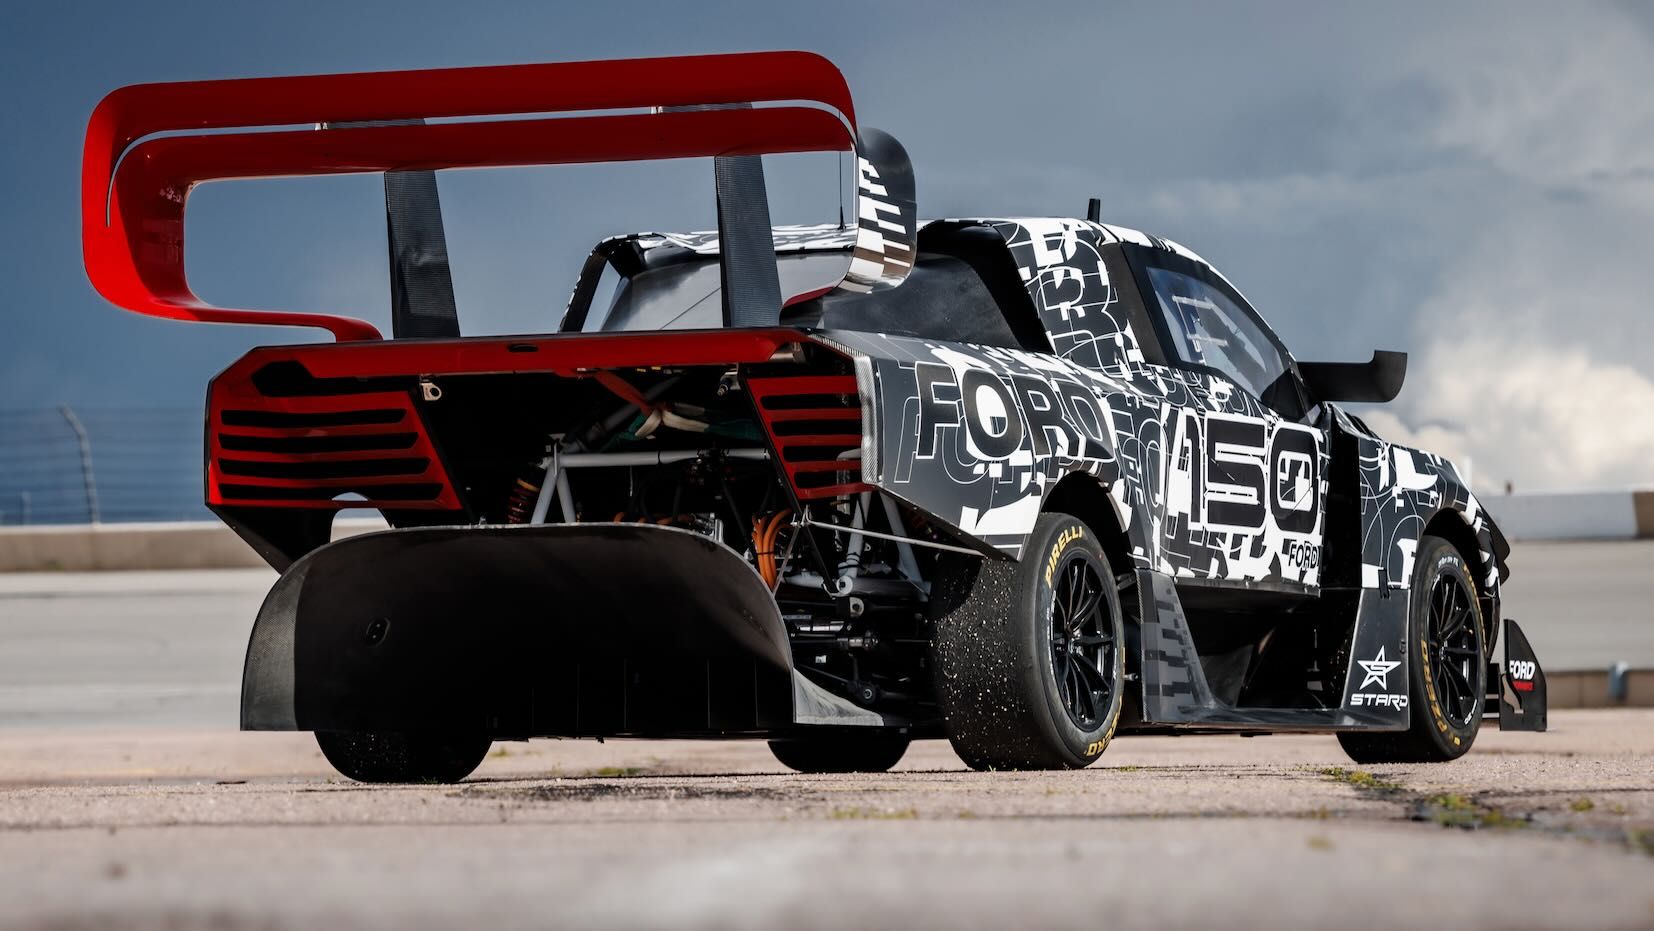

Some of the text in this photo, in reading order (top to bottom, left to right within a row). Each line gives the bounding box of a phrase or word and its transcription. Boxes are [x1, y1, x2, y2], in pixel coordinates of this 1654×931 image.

[914, 360, 1117, 463] FORD
[1044, 525, 1083, 589] PIRELLI
[1288, 543, 1318, 569] FORD
[1509, 660, 1537, 681] FORD
[1350, 694, 1409, 711] STARD
